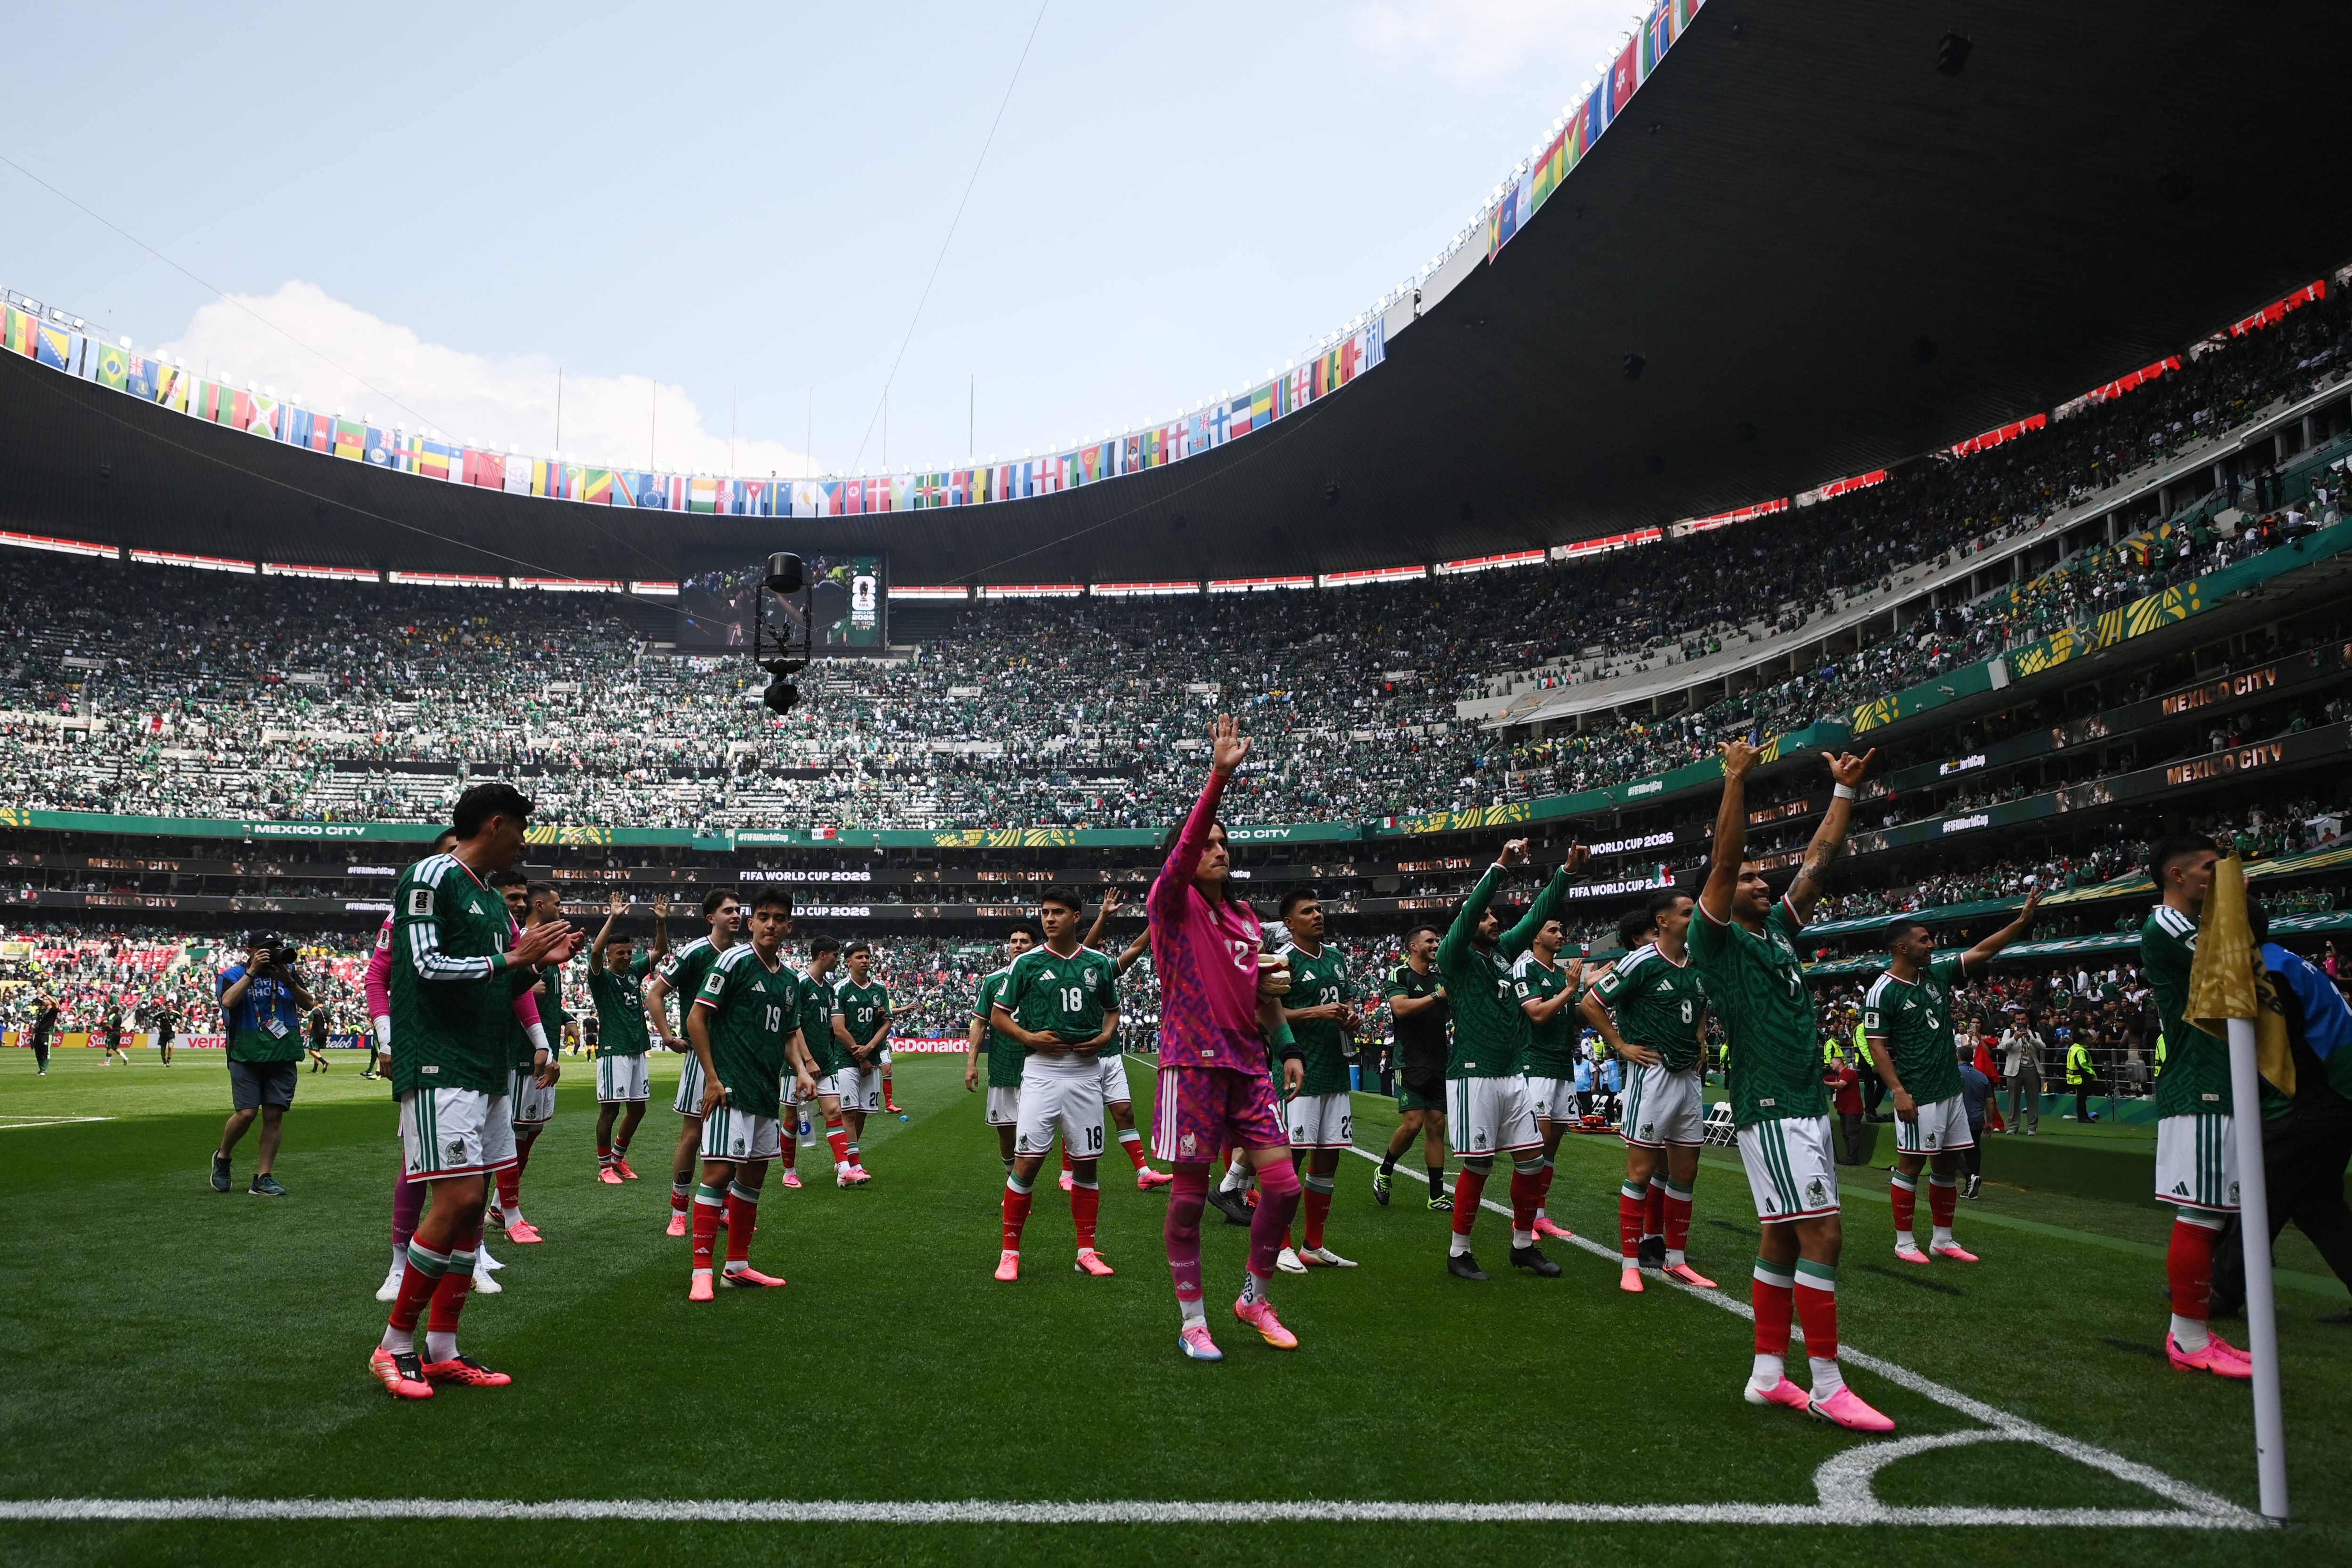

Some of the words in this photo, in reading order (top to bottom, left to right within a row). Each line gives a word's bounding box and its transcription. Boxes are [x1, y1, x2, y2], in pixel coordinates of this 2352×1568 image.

[2162, 681, 2230, 715] MEXICO
[2234, 668, 2277, 695] CITY
[2167, 754, 2234, 785] MEXICO
[2239, 743, 2282, 769] CITY
[1627, 780, 1663, 796] #FIFAWorldCup
[1749, 805, 1785, 824] MEXICO
[1787, 800, 1809, 816] CITY
[255, 825, 322, 834] MEXICO
[325, 826, 366, 835] CITY
[1943, 814, 1989, 833] #FIFAWorldCup
[737, 833, 789, 842] #FIFAWorldCup
[1254, 829, 1291, 838] CITY
[1589, 840, 1624, 855] WORLD
[1624, 838, 1643, 850] CUP
[1644, 832, 1674, 848] 2026
[88, 858, 144, 869] MEXICO
[148, 861, 181, 871] CITY
[1397, 859, 1443, 872] MEXICO
[1445, 858, 1472, 869] CITY
[1789, 851, 1806, 865] CIT
[347, 866, 396, 876] #FIFAWorldCup
[552, 870, 601, 879] MEXICO
[603, 870, 632, 879] CITY
[739, 872, 764, 881] FIFA
[765, 872, 806, 881] WORLD
[807, 872, 830, 881] CUP
[831, 872, 871, 881] 2026
[977, 872, 1024, 881] MEXICO
[1027, 872, 1054, 881] CITY
[1569, 886, 1591, 898] FIFA
[1591, 882, 1625, 896] WORLD
[1625, 880, 1644, 892] CUP
[85, 896, 141, 906] MEXICO
[145, 897, 178, 908] CITY
[345, 903, 394, 912] #FIFAWorldCup
[1398, 897, 1444, 909] MEXICO
[563, 905, 600, 915] EXICO
[806, 907, 829, 916] CUP
[830, 906, 871, 917] 2026
[976, 907, 1024, 916] MEXICO
[624, 992, 638, 1006] 25
[1060, 987, 1082, 1012] 18
[1320, 986, 1339, 1005] 23
[765, 1004, 781, 1032] 19
[819, 1006, 828, 1023] 14
[857, 1007, 873, 1023] 20
[1681, 999, 1692, 1024] 8
[1925, 1008, 1939, 1030] 6
[869, 1091, 880, 1107] 20
[799, 1111, 807, 1132] smart
[1086, 1125, 1102, 1151] 18
